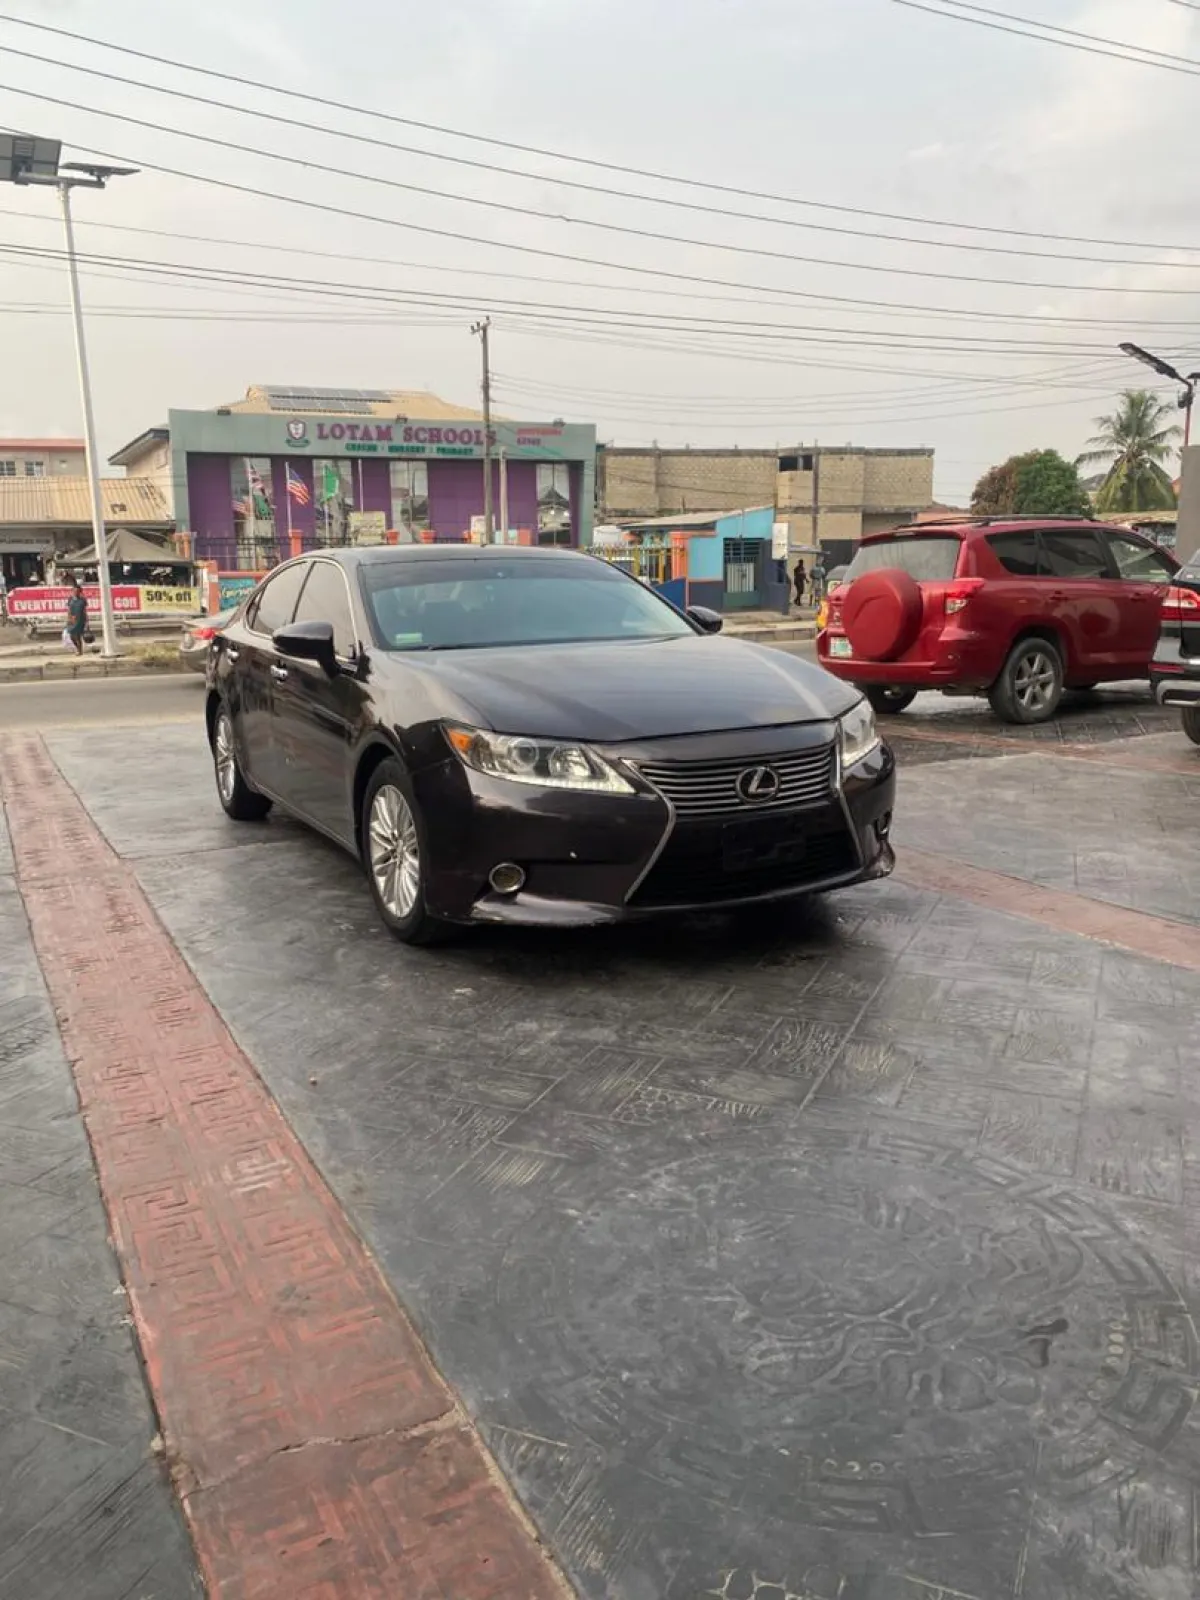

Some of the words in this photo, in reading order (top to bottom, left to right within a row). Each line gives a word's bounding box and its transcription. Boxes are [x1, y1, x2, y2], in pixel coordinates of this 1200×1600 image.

[317, 423, 393, 441] LOTAM
[403, 426, 497, 447] SCHOOLS
[146, 590, 172, 602] 50%
[175, 590, 192, 601] off
[14, 599, 69, 611] EVERYTHI
